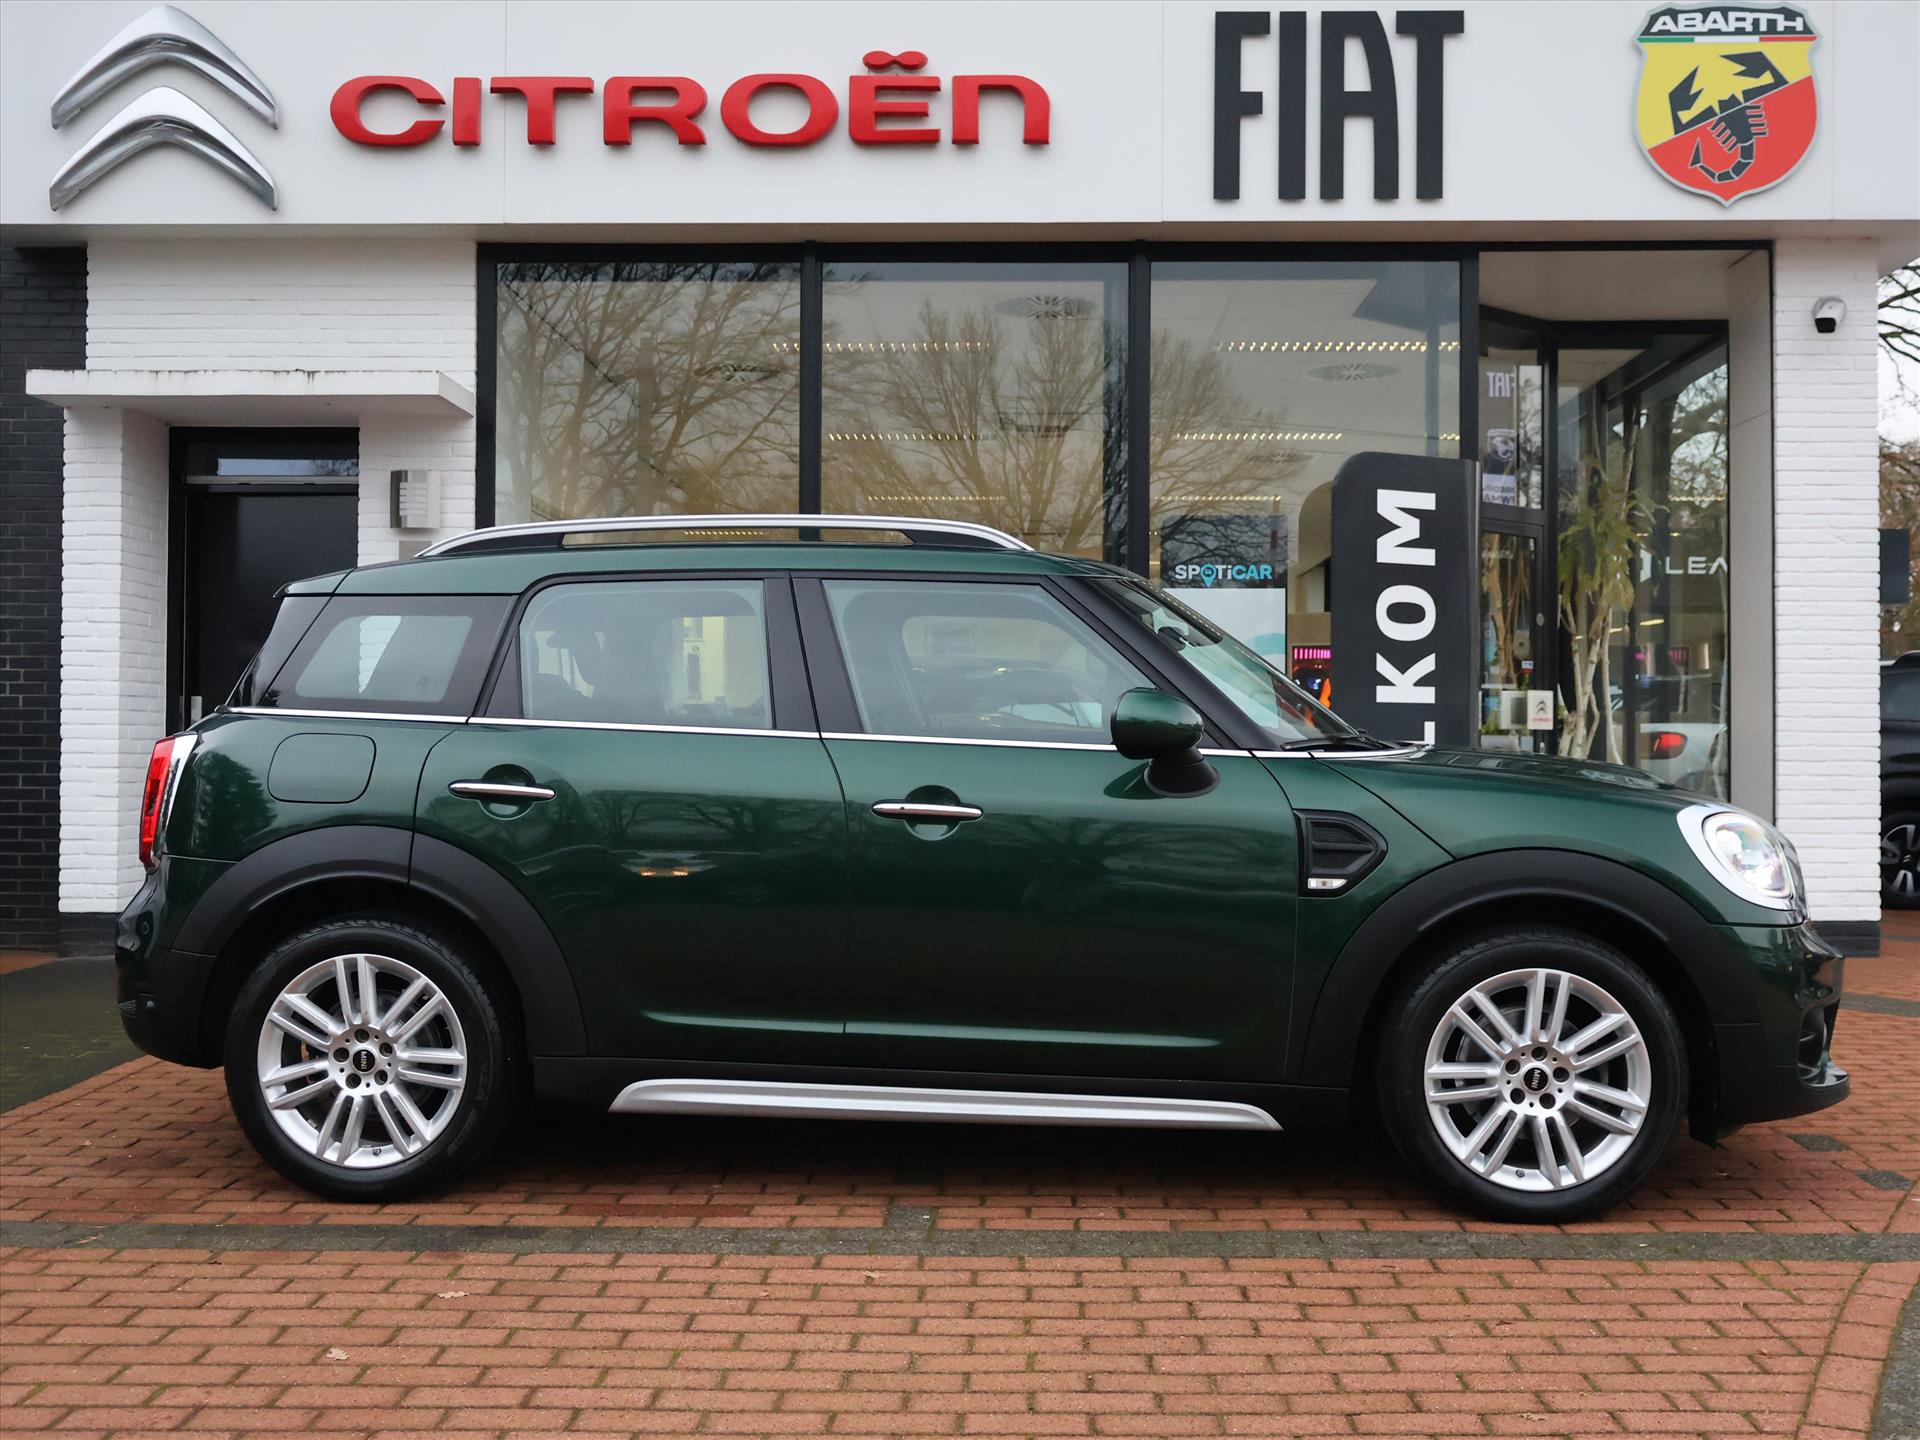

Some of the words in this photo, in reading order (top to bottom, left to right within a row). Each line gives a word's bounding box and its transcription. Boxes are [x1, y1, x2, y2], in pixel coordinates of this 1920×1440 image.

[1649, 10, 1804, 33] ABARTH
[330, 51, 1050, 147] CITROËN
[1213, 10, 1464, 201] FIAT
[360, 1050, 368, 1070] MINI
[1531, 1069, 1541, 1089] MINI
